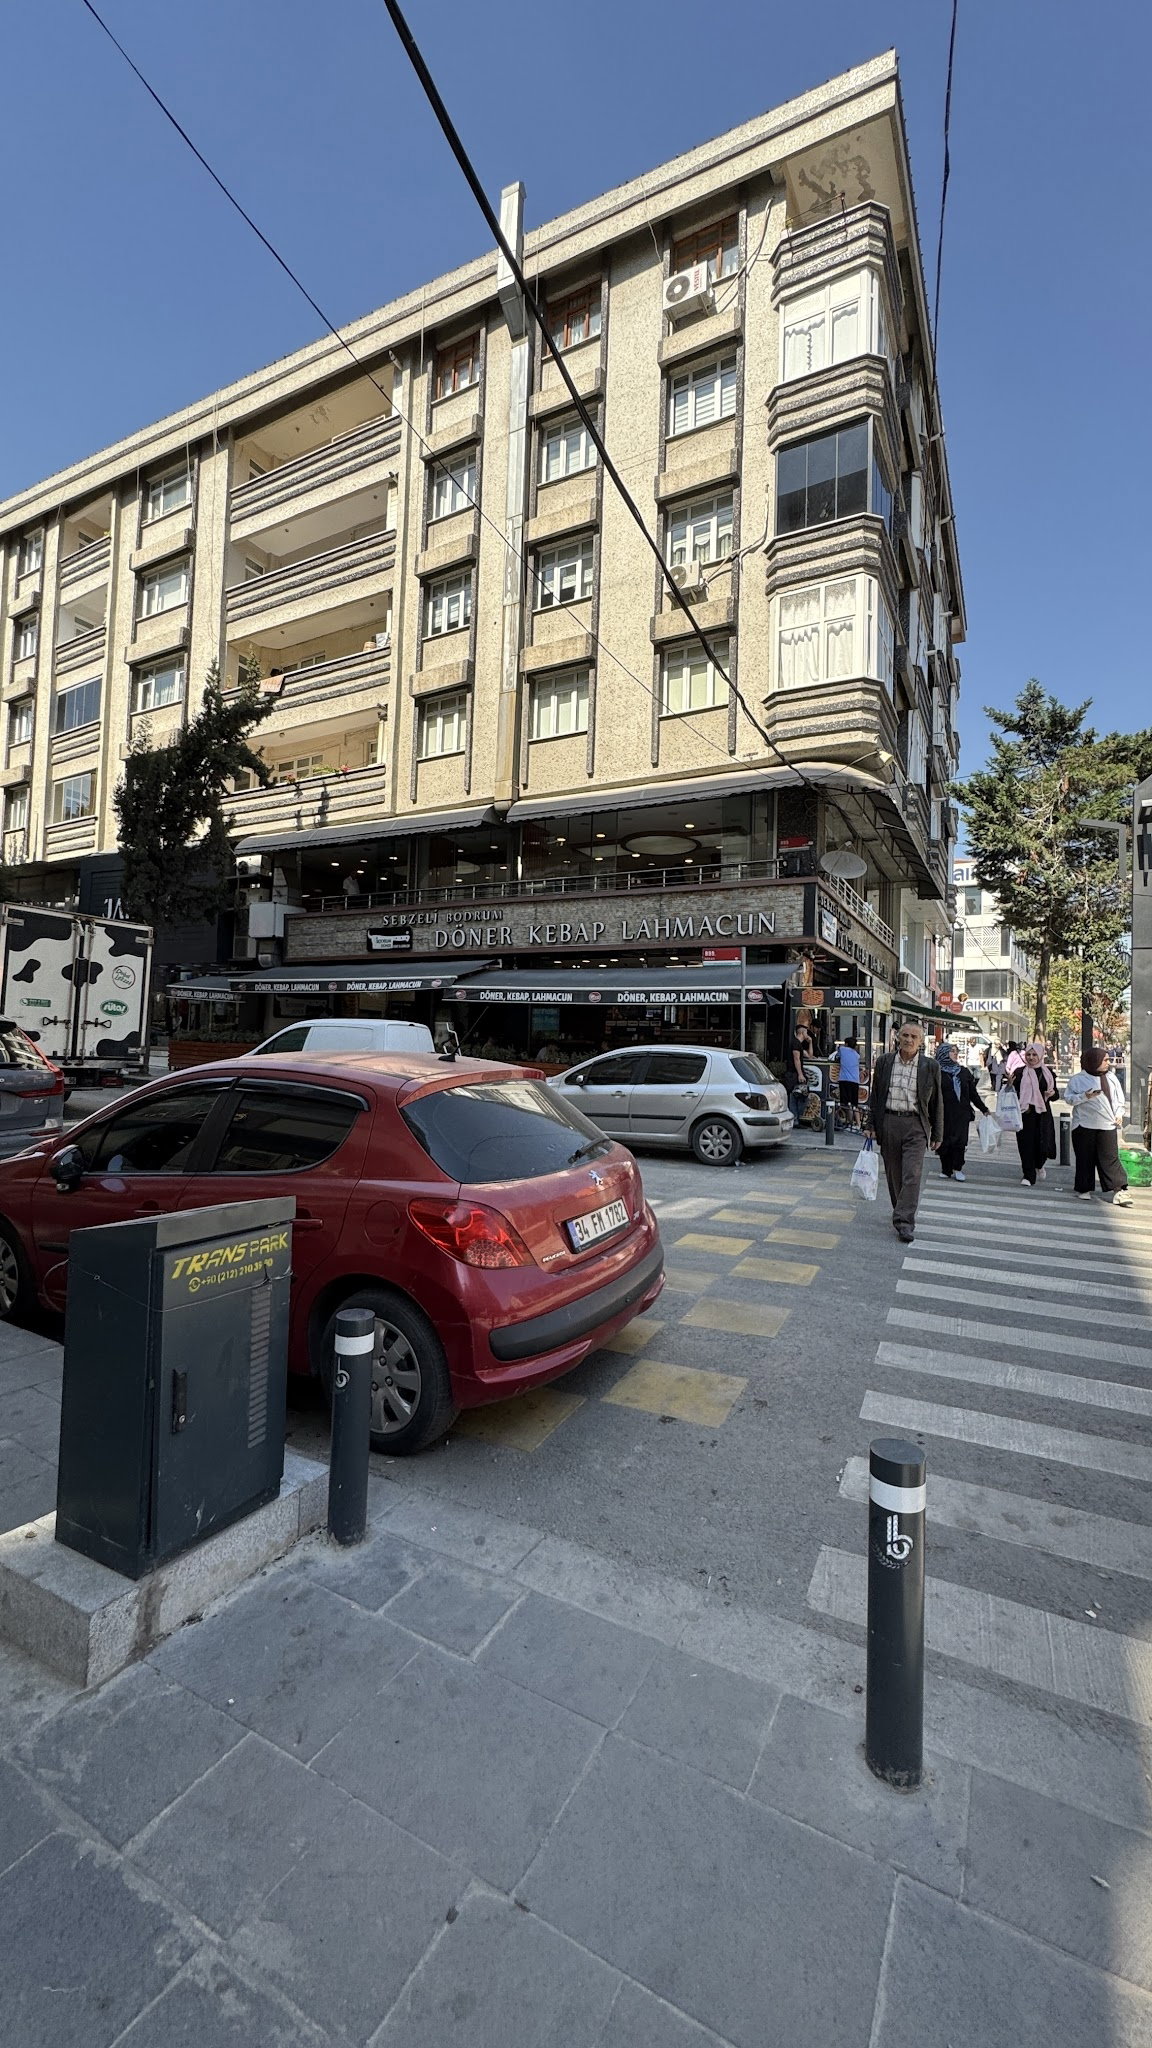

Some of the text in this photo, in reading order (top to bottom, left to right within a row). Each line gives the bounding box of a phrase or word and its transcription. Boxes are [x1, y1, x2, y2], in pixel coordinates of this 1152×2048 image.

[383, 909, 504, 926] SEBZELİ BODRUM
[435, 911, 776, 948] DÖNER KEBAP LAHMACUN
[347, 981, 367, 991] DÖNER,
[368, 980, 388, 991] KEBAP,
[388, 980, 422, 990] LAHMACUN
[480, 989, 572, 1002] DÖNER, KEBAP, LAHMACUN
[617, 990, 729, 1004] DÖNER, KEBAP, LAHMACUN
[834, 990, 873, 999] BODRUM
[575, 1221, 590, 1241] 34
[171, 1232, 289, 1279] TRANS PARK
